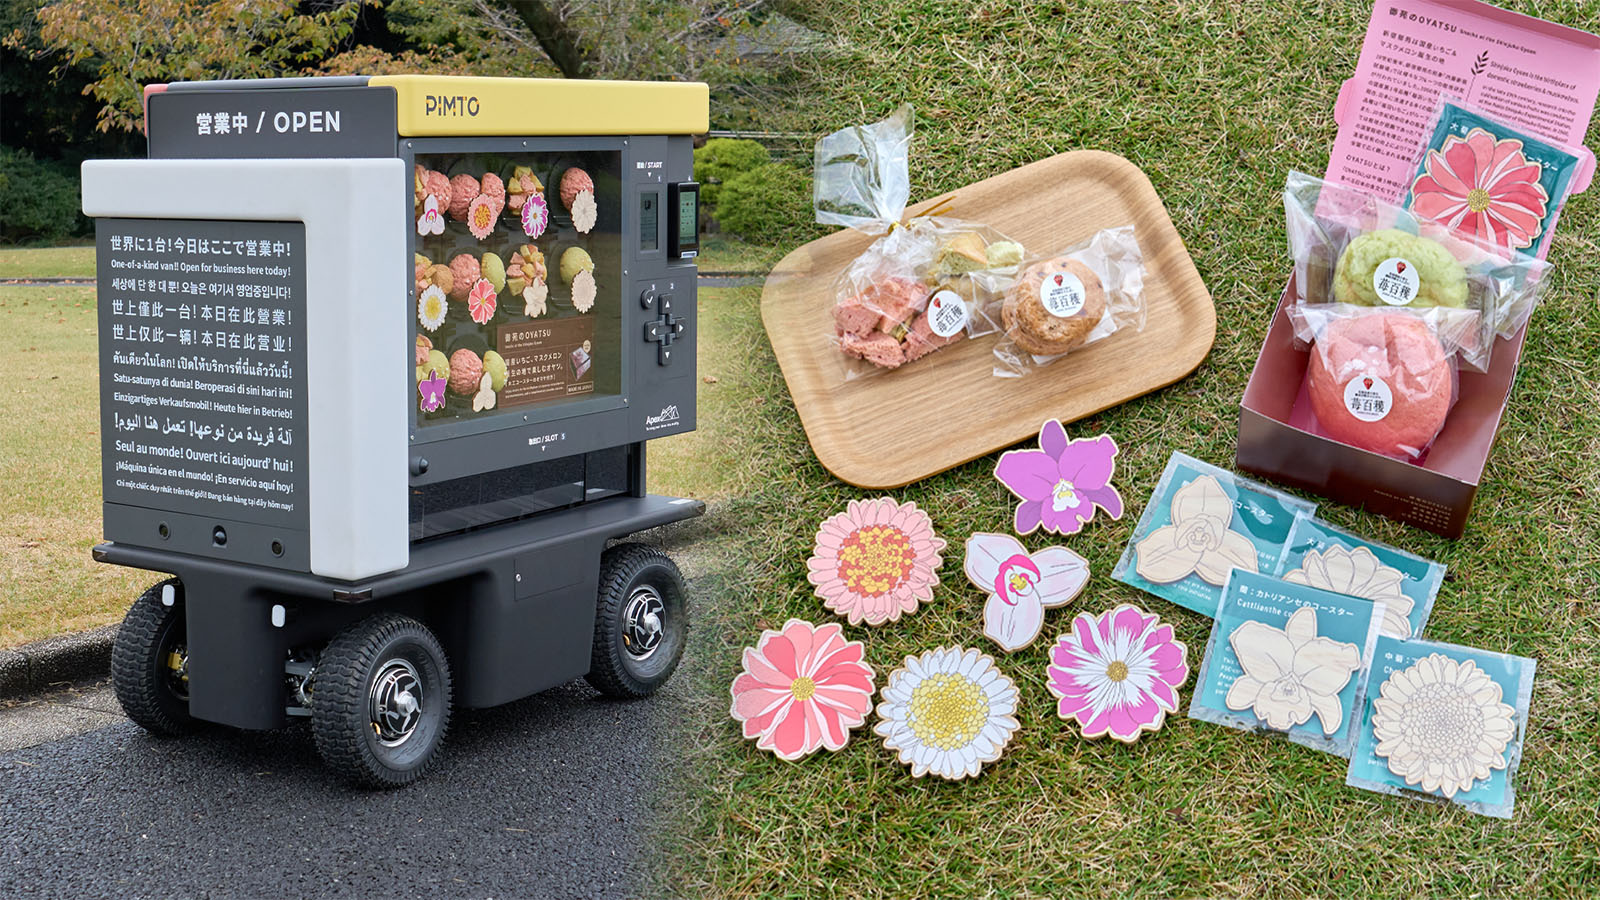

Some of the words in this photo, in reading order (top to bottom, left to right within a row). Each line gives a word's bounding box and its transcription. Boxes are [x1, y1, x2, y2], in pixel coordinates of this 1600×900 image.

[426, 96, 480, 117] PIMTO
[196, 112, 248, 136] 営業中
[274, 110, 341, 133] OPEN
[111, 258, 159, 271] One-of-a-kind
[160, 262, 179, 271] van!!
[180, 262, 200, 274] Open
[201, 262, 212, 272] for
[214, 264, 246, 274] business
[246, 264, 264, 276] here
[264, 266, 291, 278] today!
[112, 278, 136, 290] 세상에
[138, 278, 146, 292] 단
[148, 279, 156, 292] 한
[158, 280, 167, 293] 대
[168, 280, 180, 294] 뿐!
[182, 282, 207, 295] 오늘은
[208, 282, 234, 297] 여기서
[236, 284, 291, 300] 영업중입니다!
[114, 373, 161, 388] Satu-satunya
[162, 376, 169, 386] di
[170, 377, 194, 389] dunia!
[194, 378, 236, 394] Beroperasi
[237, 383, 245, 394] di
[246, 386, 260, 396] sini
[261, 386, 278, 398] hari
[278, 388, 292, 399] ini!
[114, 392, 158, 406] Einzigartiges
[158, 396, 212, 410] Verkaufsmobil!
[214, 402, 236, 414] Heute
[237, 404, 252, 414] hier
[253, 405, 260, 416] in
[262, 407, 292, 419] Betrieb!
[144, 414, 159, 430] هنا
[162, 417, 186, 434] تعمل
[227, 428, 244, 442] من
[545, 434, 558, 442] SLOT
[116, 440, 135, 452] Seul
[136, 444, 148, 454] au
[149, 444, 184, 458] monde!
[186, 448, 218, 464] Ouvert
[220, 452, 231, 465] ici
[273, 460, 293, 472] hui!
[116, 460, 148, 474] ¡Máquina
[148, 464, 168, 476] única
[168, 468, 177, 477] en
[178, 468, 185, 478] el
[186, 471, 214, 482] mundo!
[214, 474, 228, 484] ¡En
[228, 476, 258, 488] servicio
[258, 480, 276, 492] aquí
[276, 482, 294, 494] hoy!
